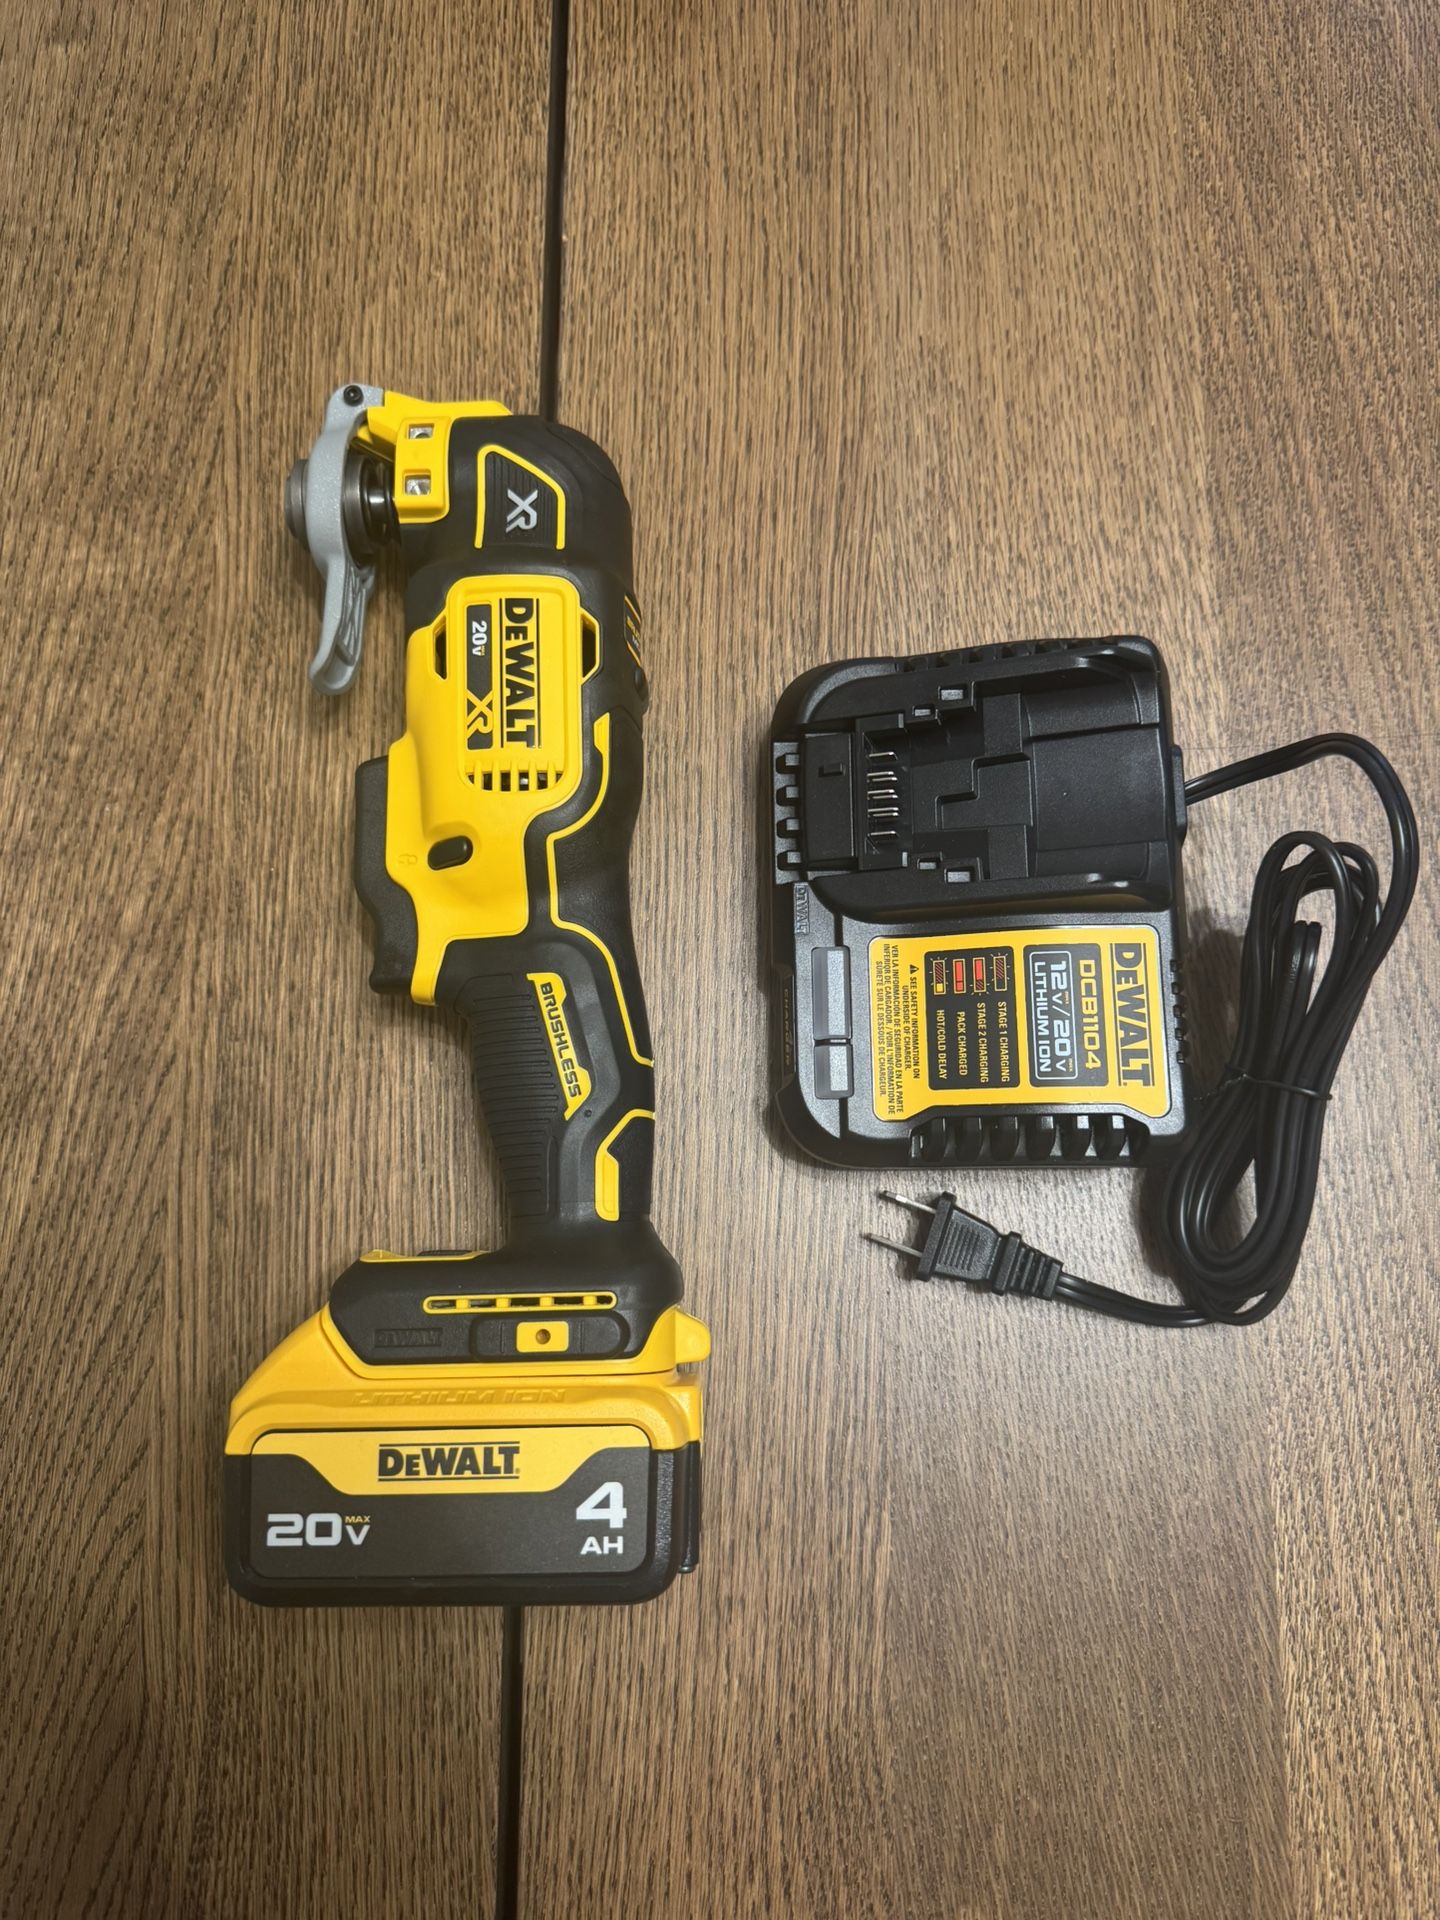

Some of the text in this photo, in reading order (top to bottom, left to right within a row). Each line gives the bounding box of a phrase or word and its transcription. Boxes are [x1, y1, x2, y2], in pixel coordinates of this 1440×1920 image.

[506, 489, 538, 533] XR
[883, 943, 891, 975] INFERIOR
[892, 959, 900, 968] LA
[884, 975, 892, 985] DE
[876, 988, 885, 1002] SUR
[877, 1003, 885, 1012] LE
[902, 985, 911, 1025] UNDERSIDE
[893, 1018, 901, 1028] DE
[910, 976, 920, 1079] SEE SAFETY INFORMATION ON
[976, 1002, 987, 1030] STAGE
[997, 1001, 1008, 1029] STAGE
[1034, 962, 1052, 1072] LITHIUM ION
[1079, 959, 1101, 1070] DCB1104
[540, 981, 582, 1098] BRUSHLESS
[877, 1012, 886, 1046] DESSOUS
[886, 1031, 894, 1048] VOIR
[903, 1026, 911, 1035] OF
[878, 1047, 886, 1056] DE
[894, 1029, 902, 1068] SEGURIDAD
[936, 1009, 947, 1080] HOT/COLD DELAY
[957, 1011, 968, 1076] PACK CHARGED
[978, 1038, 989, 1083] CHARGING
[999, 1037, 1010, 1082] CHARGING
[895, 1069, 903, 1080] EN
[895, 1080, 903, 1090] LA
[888, 1105, 896, 1115] DE
[896, 1091, 904, 1113] PARTE
[351, 1388, 567, 1407] LITHIUM ION
[344, 1515, 371, 1523] MAX
[576, 1481, 627, 1529] 4
[580, 1535, 624, 1555] AH
